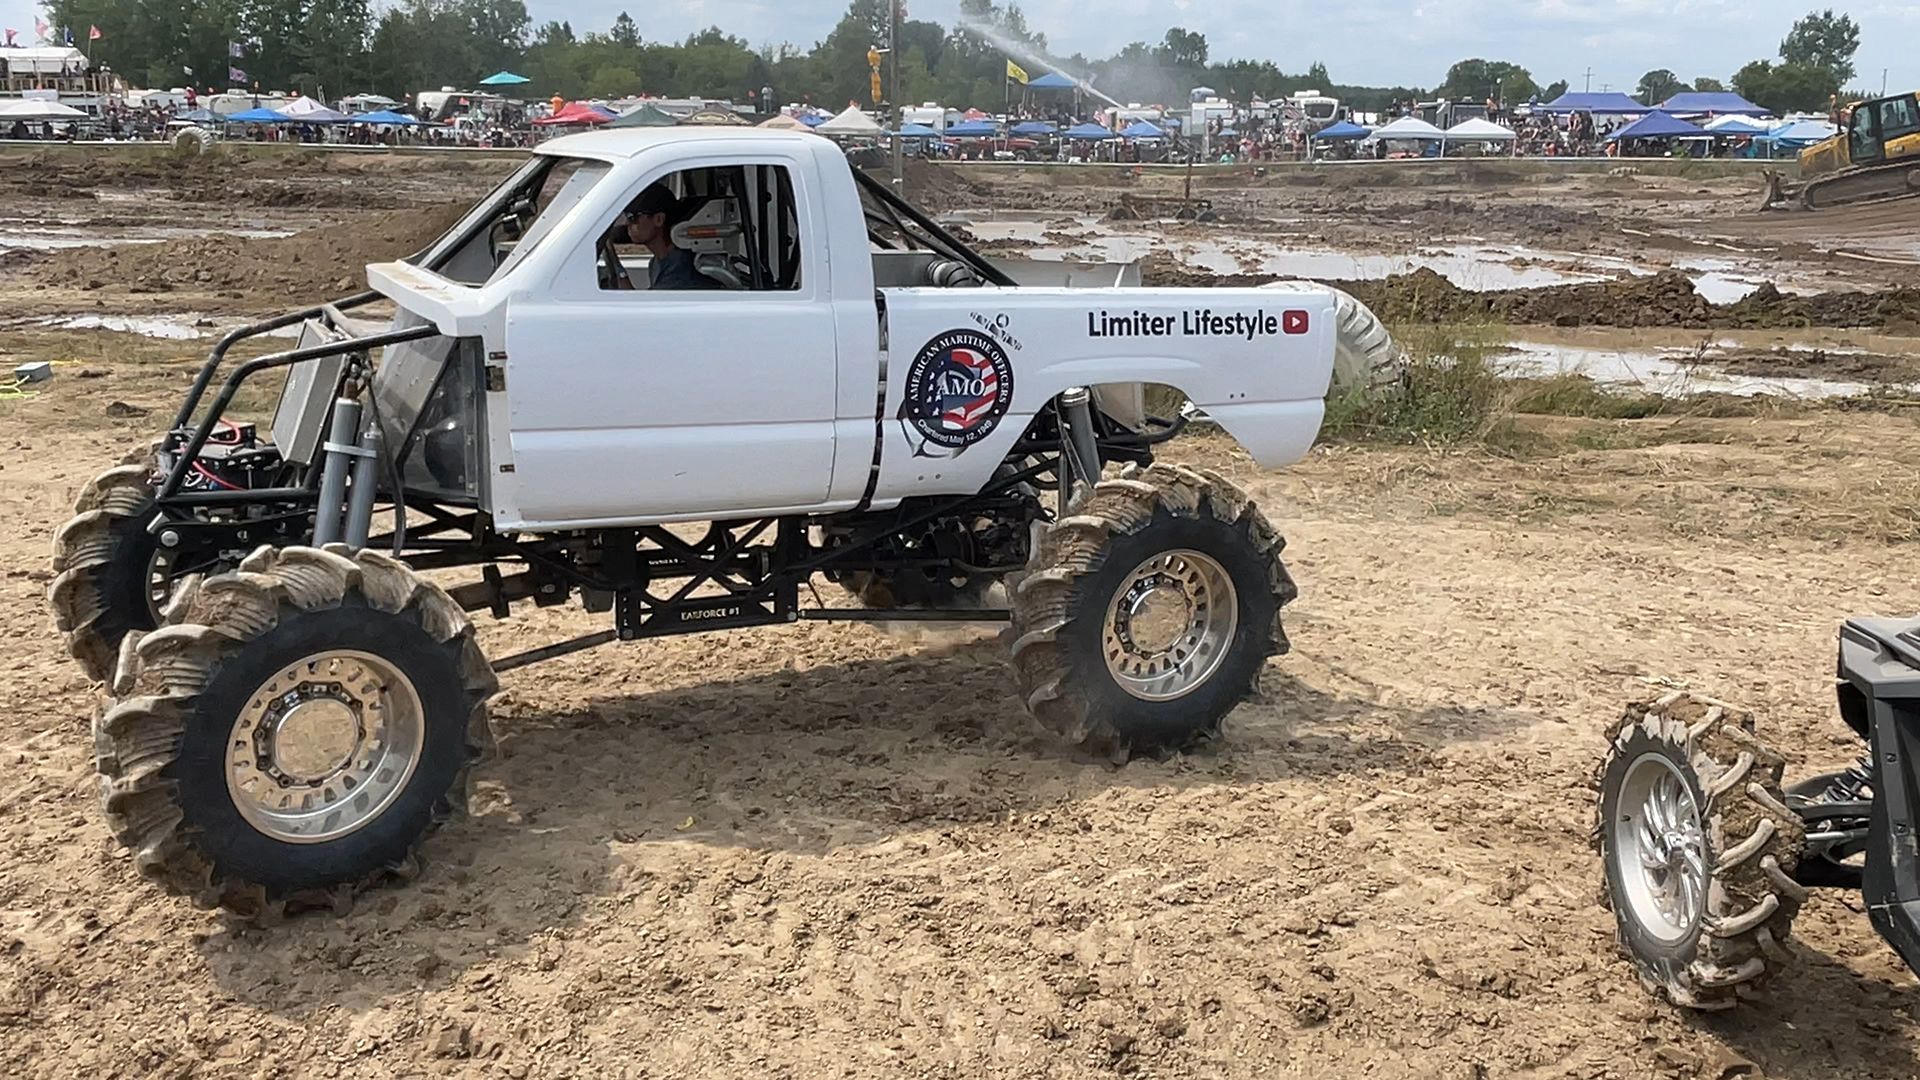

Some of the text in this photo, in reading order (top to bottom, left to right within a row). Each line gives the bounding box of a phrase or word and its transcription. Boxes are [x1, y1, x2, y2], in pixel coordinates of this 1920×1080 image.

[1088, 309, 1278, 341] Limiter Lifestyle
[910, 334, 1009, 404] AMERICAN MARITIME OFFICERS
[936, 378, 985, 396] AMO
[917, 418, 950, 443] Chartered
[949, 435, 965, 445] May
[977, 419, 993, 436] 1949
